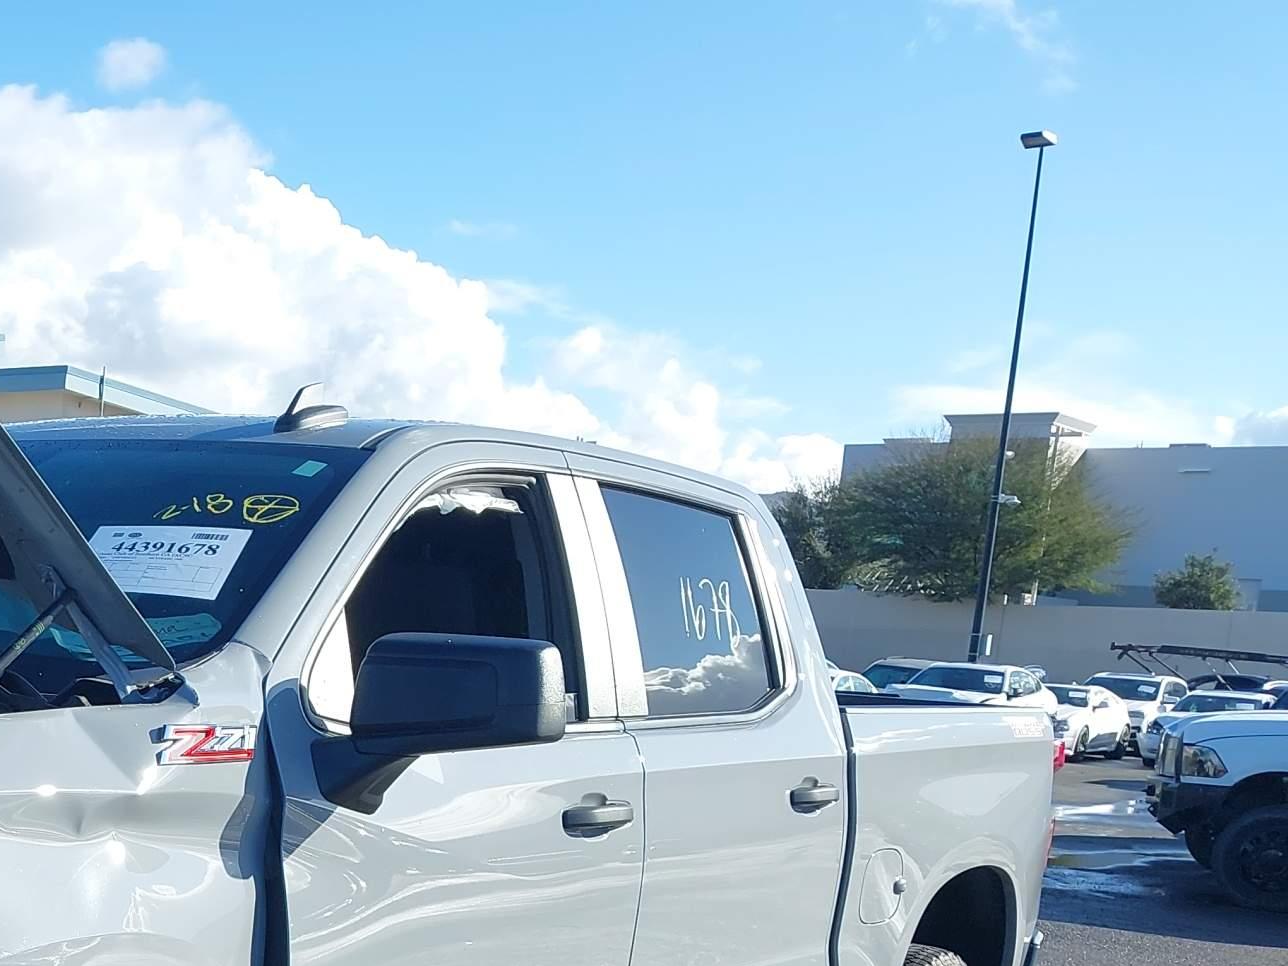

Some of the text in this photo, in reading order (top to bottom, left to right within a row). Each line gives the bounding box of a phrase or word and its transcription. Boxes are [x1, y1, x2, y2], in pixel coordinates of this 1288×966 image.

[111, 541, 221, 556] 44391678
[679, 576, 740, 655] 1678
[149, 724, 257, 766] Z71
